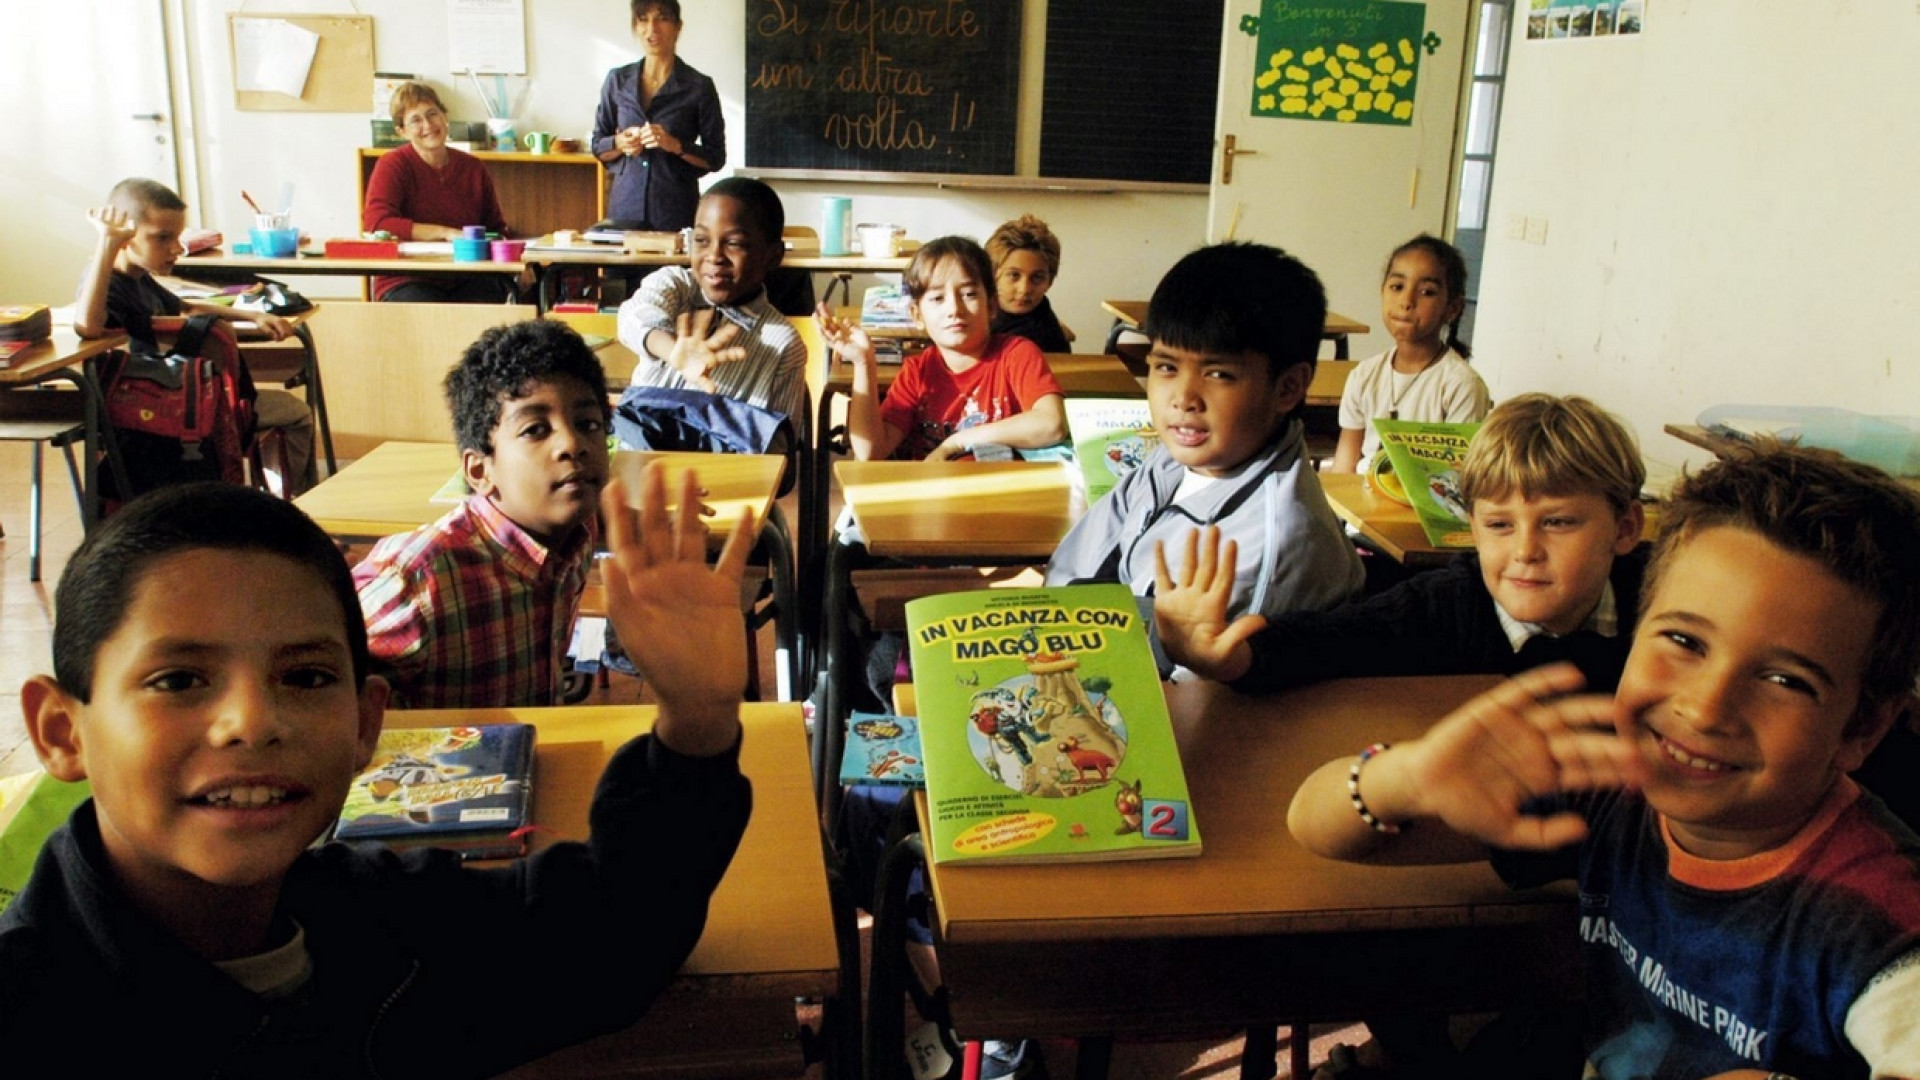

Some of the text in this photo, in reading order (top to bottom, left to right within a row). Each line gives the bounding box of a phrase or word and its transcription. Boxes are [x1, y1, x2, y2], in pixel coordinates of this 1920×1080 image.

[920, 609, 1129, 643] IN VACANZA CON
[956, 632, 1103, 660] MAGO BLU
[937, 796, 979, 806] QUADERNO
[939, 813, 953, 821] PER
[967, 810, 993, 818] CLASSE
[974, 815, 1027, 833] con schede
[1150, 805, 1177, 835] 2
[955, 839, 964, 848] di
[966, 834, 988, 844] area
[1639, 956, 1711, 1029] MARINE
[1714, 1005, 1768, 1061] PARK
